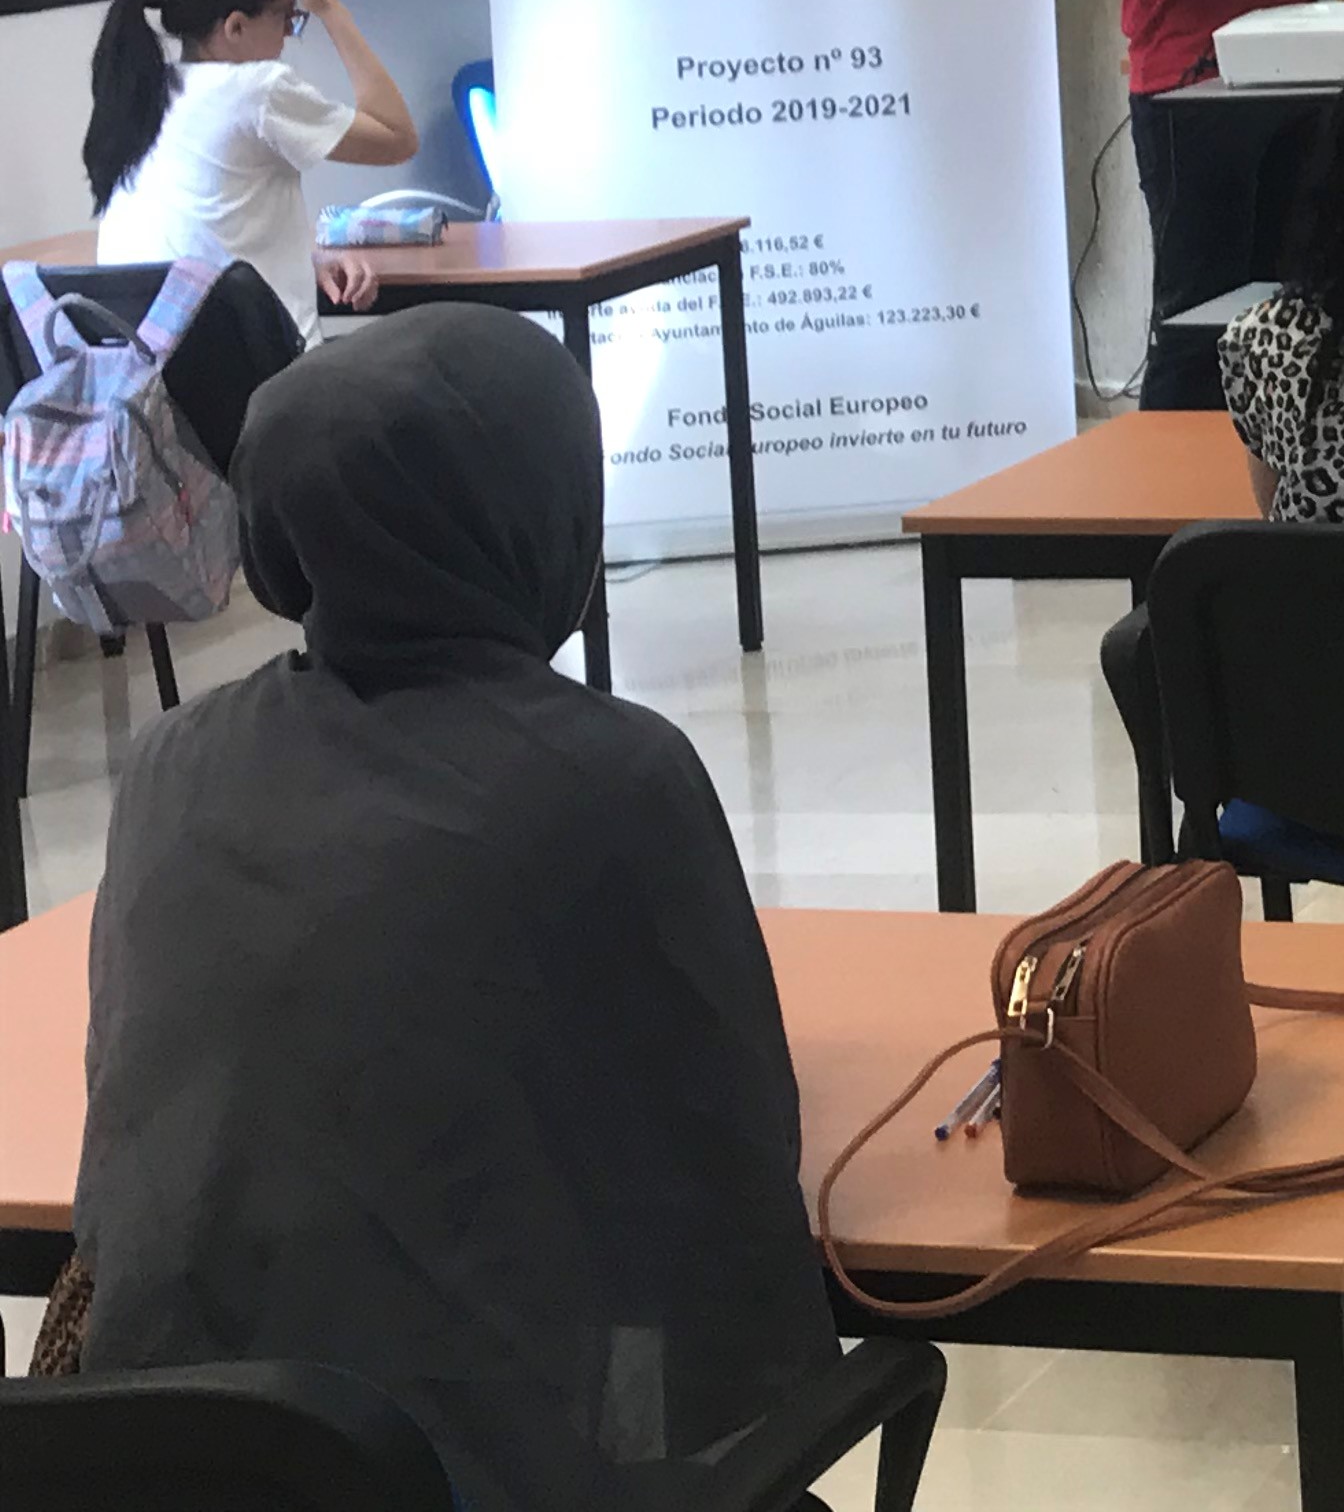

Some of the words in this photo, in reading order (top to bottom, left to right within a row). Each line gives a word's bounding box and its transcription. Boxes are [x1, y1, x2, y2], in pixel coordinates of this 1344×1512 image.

[677, 51, 804, 82] Proyecto
[850, 45, 883, 70] 93
[651, 101, 762, 130] Periodo
[771, 92, 911, 123] 2019-2021
[813, 233, 824, 249] €
[808, 258, 846, 277] 80%
[677, 296, 703, 312] del
[767, 285, 858, 306] 492.893,22
[862, 283, 873, 300] €
[651, 320, 769, 344] Ayuntamnto
[774, 317, 796, 333] de
[800, 312, 871, 333] Águilas:
[877, 304, 966, 326] 123.223,30
[970, 302, 981, 319] €
[667, 404, 728, 428] Fond
[749, 397, 822, 422] Social
[829, 393, 929, 417] Europeo
[610, 445, 662, 466] ondo
[751, 434, 824, 457] uropeo
[829, 428, 905, 450] invierte
[910, 426, 935, 443] en
[941, 421, 961, 439] tu
[966, 418, 1028, 439] futuro
